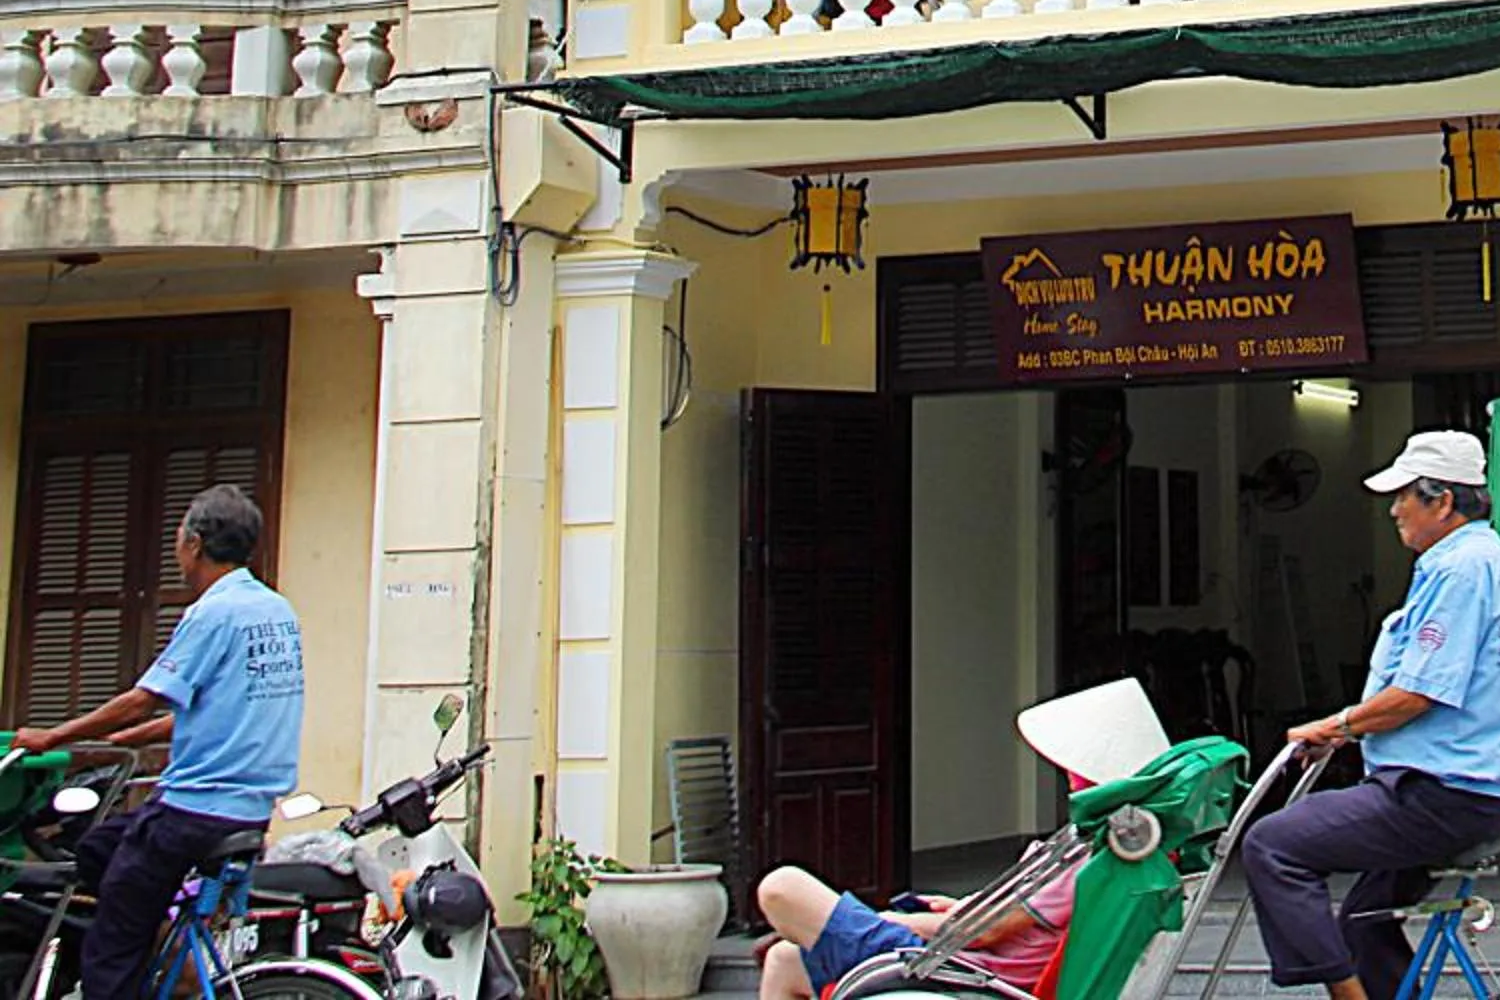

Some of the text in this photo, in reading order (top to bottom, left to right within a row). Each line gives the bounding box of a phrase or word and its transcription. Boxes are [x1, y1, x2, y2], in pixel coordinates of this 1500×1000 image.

[1102, 230, 1325, 293] THUẬN HÒA
[1143, 293, 1295, 324] HARMONY
